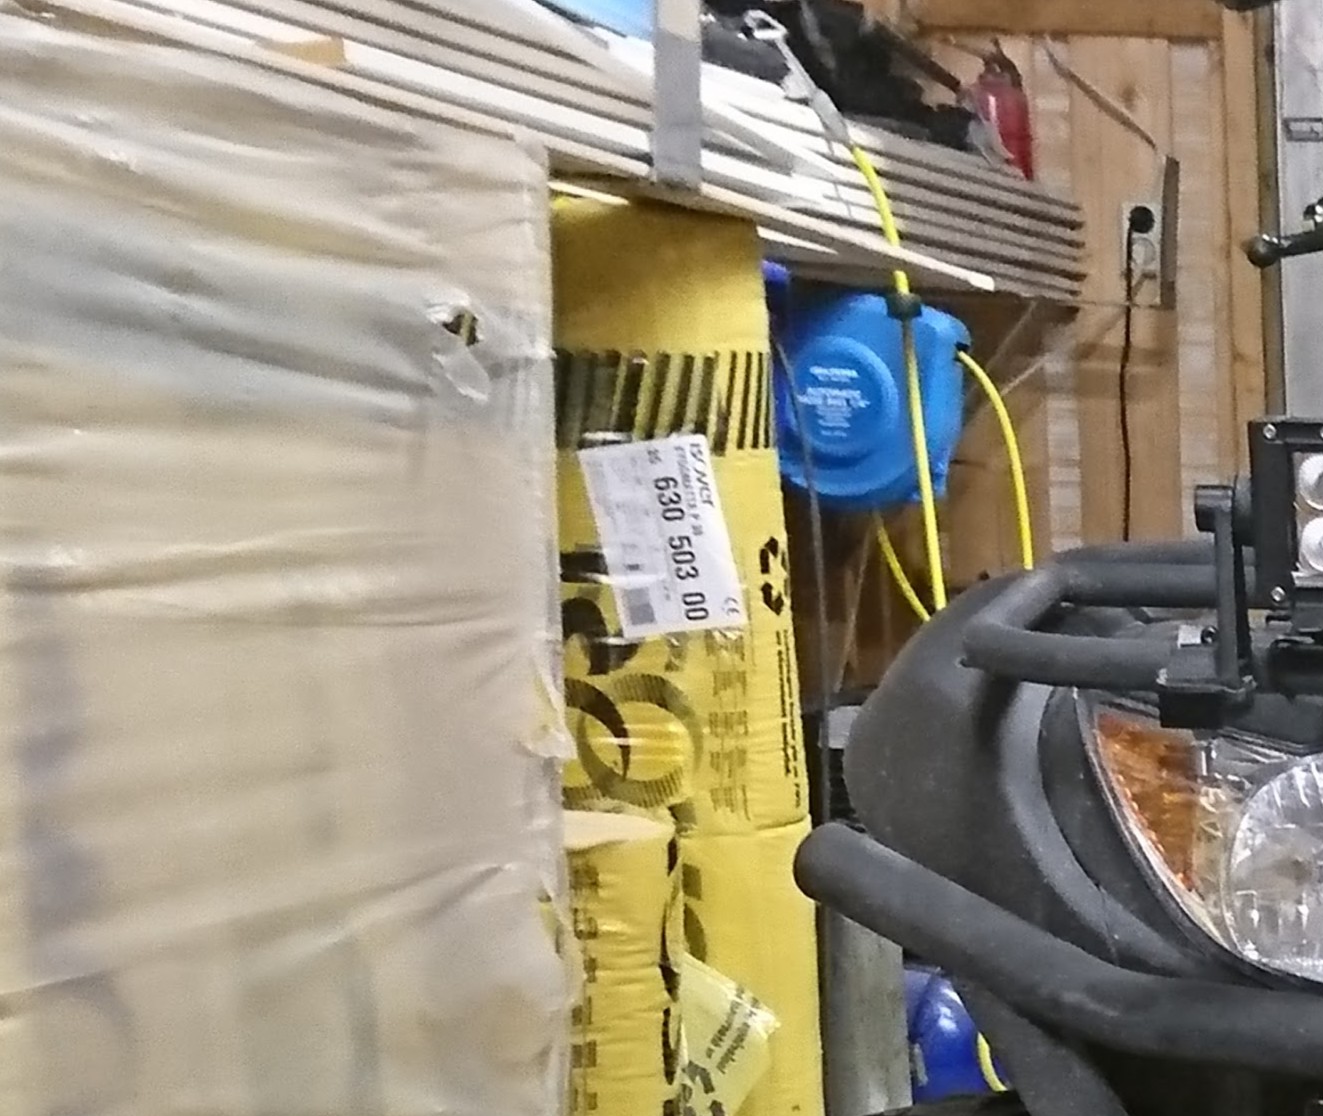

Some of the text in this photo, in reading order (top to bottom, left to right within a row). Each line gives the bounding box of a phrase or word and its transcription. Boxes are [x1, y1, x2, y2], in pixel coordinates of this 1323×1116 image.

[653, 476, 685, 522] 630
[668, 535, 699, 581] 503
[682, 592, 709, 621] 00
